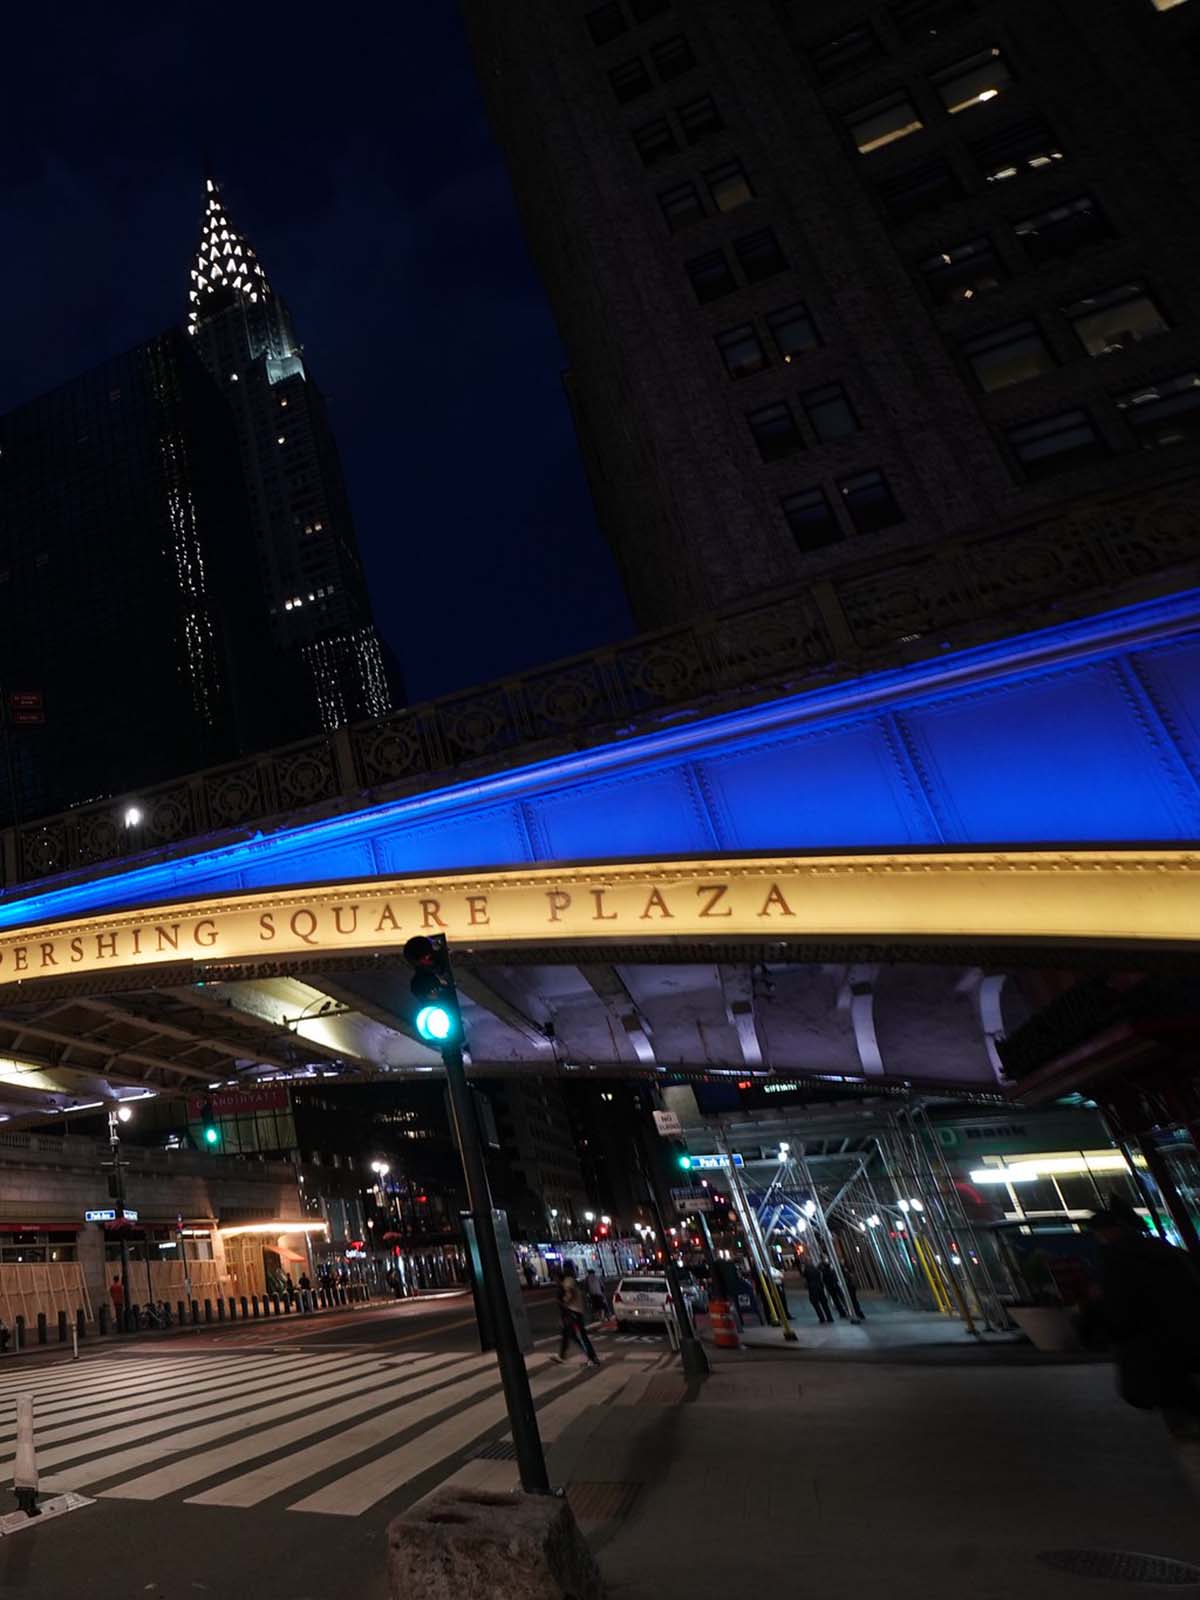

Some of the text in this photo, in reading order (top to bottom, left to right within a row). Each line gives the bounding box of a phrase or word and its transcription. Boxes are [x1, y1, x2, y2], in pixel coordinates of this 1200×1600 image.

[259, 895, 492, 945] SQUARE
[544, 883, 797, 923] PLAZA
[699, 1156, 718, 1167] Park
